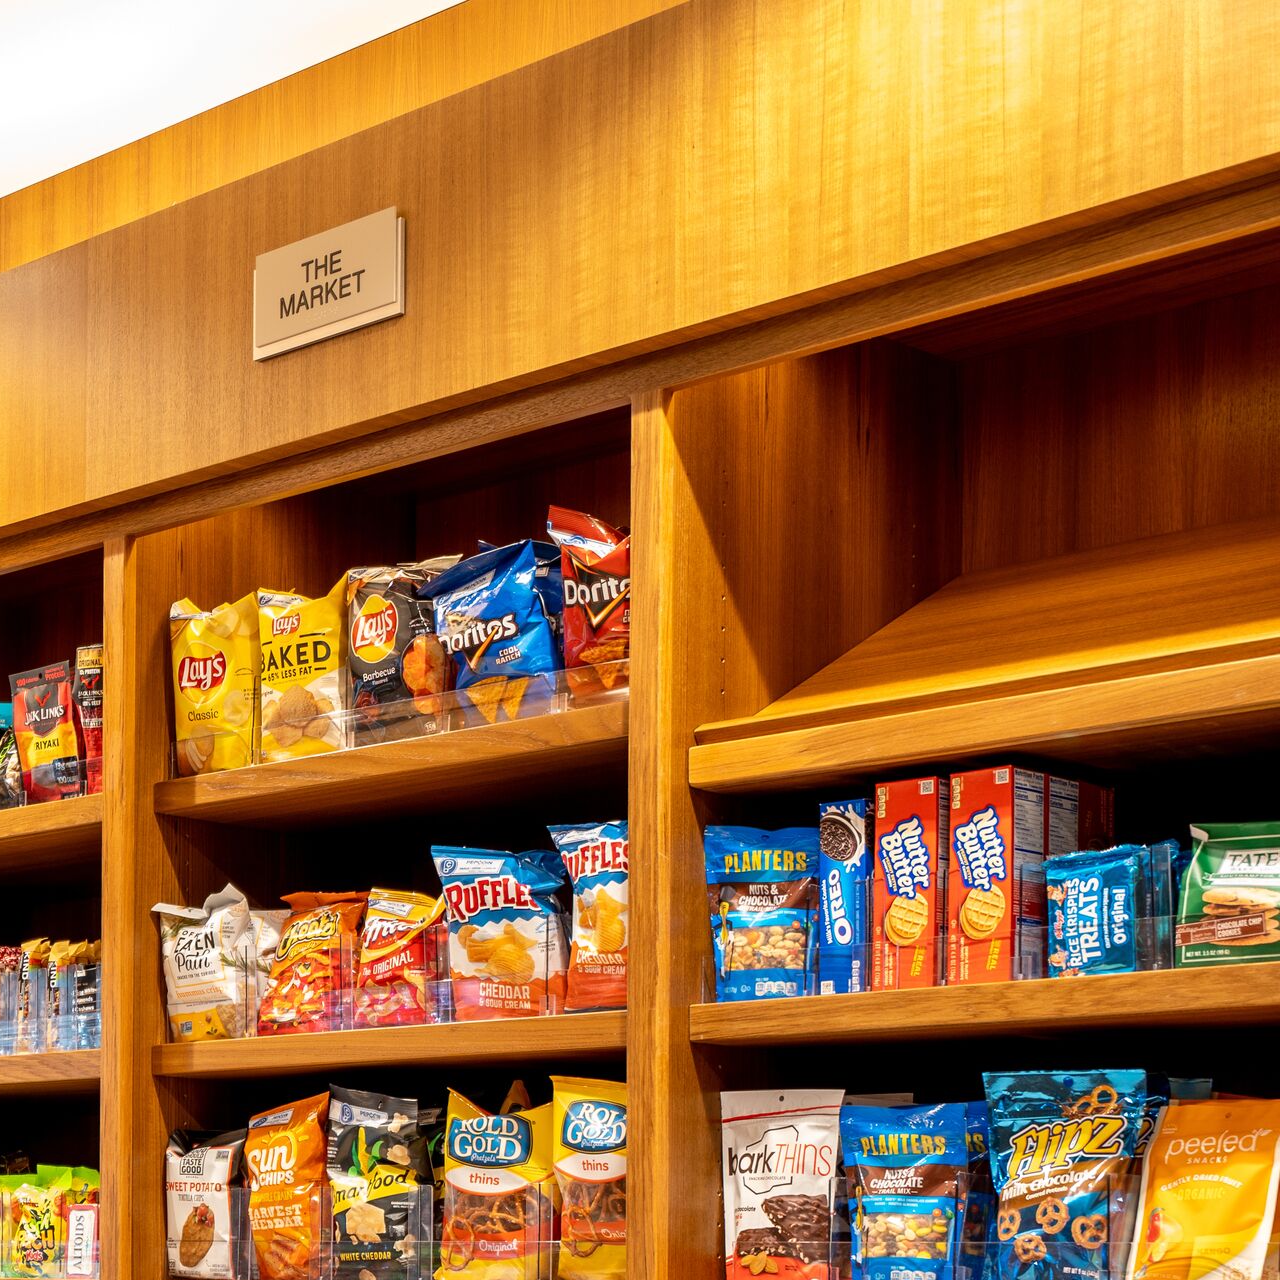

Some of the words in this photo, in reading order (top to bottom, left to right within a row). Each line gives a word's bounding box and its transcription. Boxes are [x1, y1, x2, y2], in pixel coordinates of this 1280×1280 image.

[301, 250, 342, 282] THE
[280, 269, 365, 319] MARKET
[273, 614, 299, 636] Lay's
[356, 608, 393, 647] Lay's
[496, 650, 521, 665] RANCH
[499, 645, 519, 657] COOL
[181, 653, 224, 691] Lay's
[268, 673, 279, 682] 65%
[281, 668, 297, 679] LESS
[299, 665, 312, 675] FAT
[362, 666, 396, 682] Barbecue
[25, 711, 40, 725] JACK
[41, 705, 64, 718] LINK'S
[188, 709, 219, 722] Classic
[973, 807, 1006, 880] Nutter
[898, 817, 929, 888] Nutter
[955, 822, 990, 890] Butter
[724, 850, 807, 874] PLANTERS
[881, 832, 915, 899] Butter
[749, 884, 769, 895] NUTS
[770, 884, 779, 895] &
[738, 894, 788, 906] CHOCOLATE
[829, 869, 853, 945] OREO
[1066, 878, 1079, 937] KRISPIES
[823, 900, 831, 925] Favorite
[1080, 878, 1102, 964] TREATS
[1112, 888, 1127, 944] Original
[1217, 919, 1248, 930] CHOCOLATE
[1248, 917, 1262, 926] CHIP
[1217, 928, 1242, 938] COOKIES
[576, 951, 625, 964] CHEDDAR
[1068, 938, 1083, 967] RICE
[373, 951, 414, 975] ORIGINAL
[585, 966, 601, 974] SOUR
[602, 965, 625, 975] CREAM
[480, 983, 530, 999] CHEDDAR
[486, 999, 503, 1008] SOUR
[505, 1000, 531, 1009] CREAM
[460, 1117, 519, 1135] ROLD
[454, 1134, 522, 1160] GOLD
[861, 1133, 946, 1157] PLANTERS
[1164, 1129, 1257, 1165] peeled
[182, 1158, 203, 1166] TASTE
[471, 1153, 496, 1163] Pretzels
[582, 1160, 609, 1171] thins
[1187, 1155, 1229, 1165] SNACKS
[182, 1165, 202, 1174] GOOD
[258, 1170, 294, 1186] CHIPS
[884, 1169, 903, 1180] NUTS
[190, 1182, 222, 1192] POTATO
[469, 1173, 500, 1186] thins
[870, 1177, 923, 1188] CHOCOLATE
[1160, 1175, 1192, 1192] GENTLY
[1192, 1174, 1217, 1183] DRIED
[1218, 1175, 1244, 1189] FRUIT
[1002, 1182, 1028, 1202] Milk
[73, 1216, 85, 1270] ALTOIDS
[479, 1239, 518, 1255] Original
[340, 1252, 360, 1261] WHITE
[361, 1252, 391, 1261] CHEDDAR
